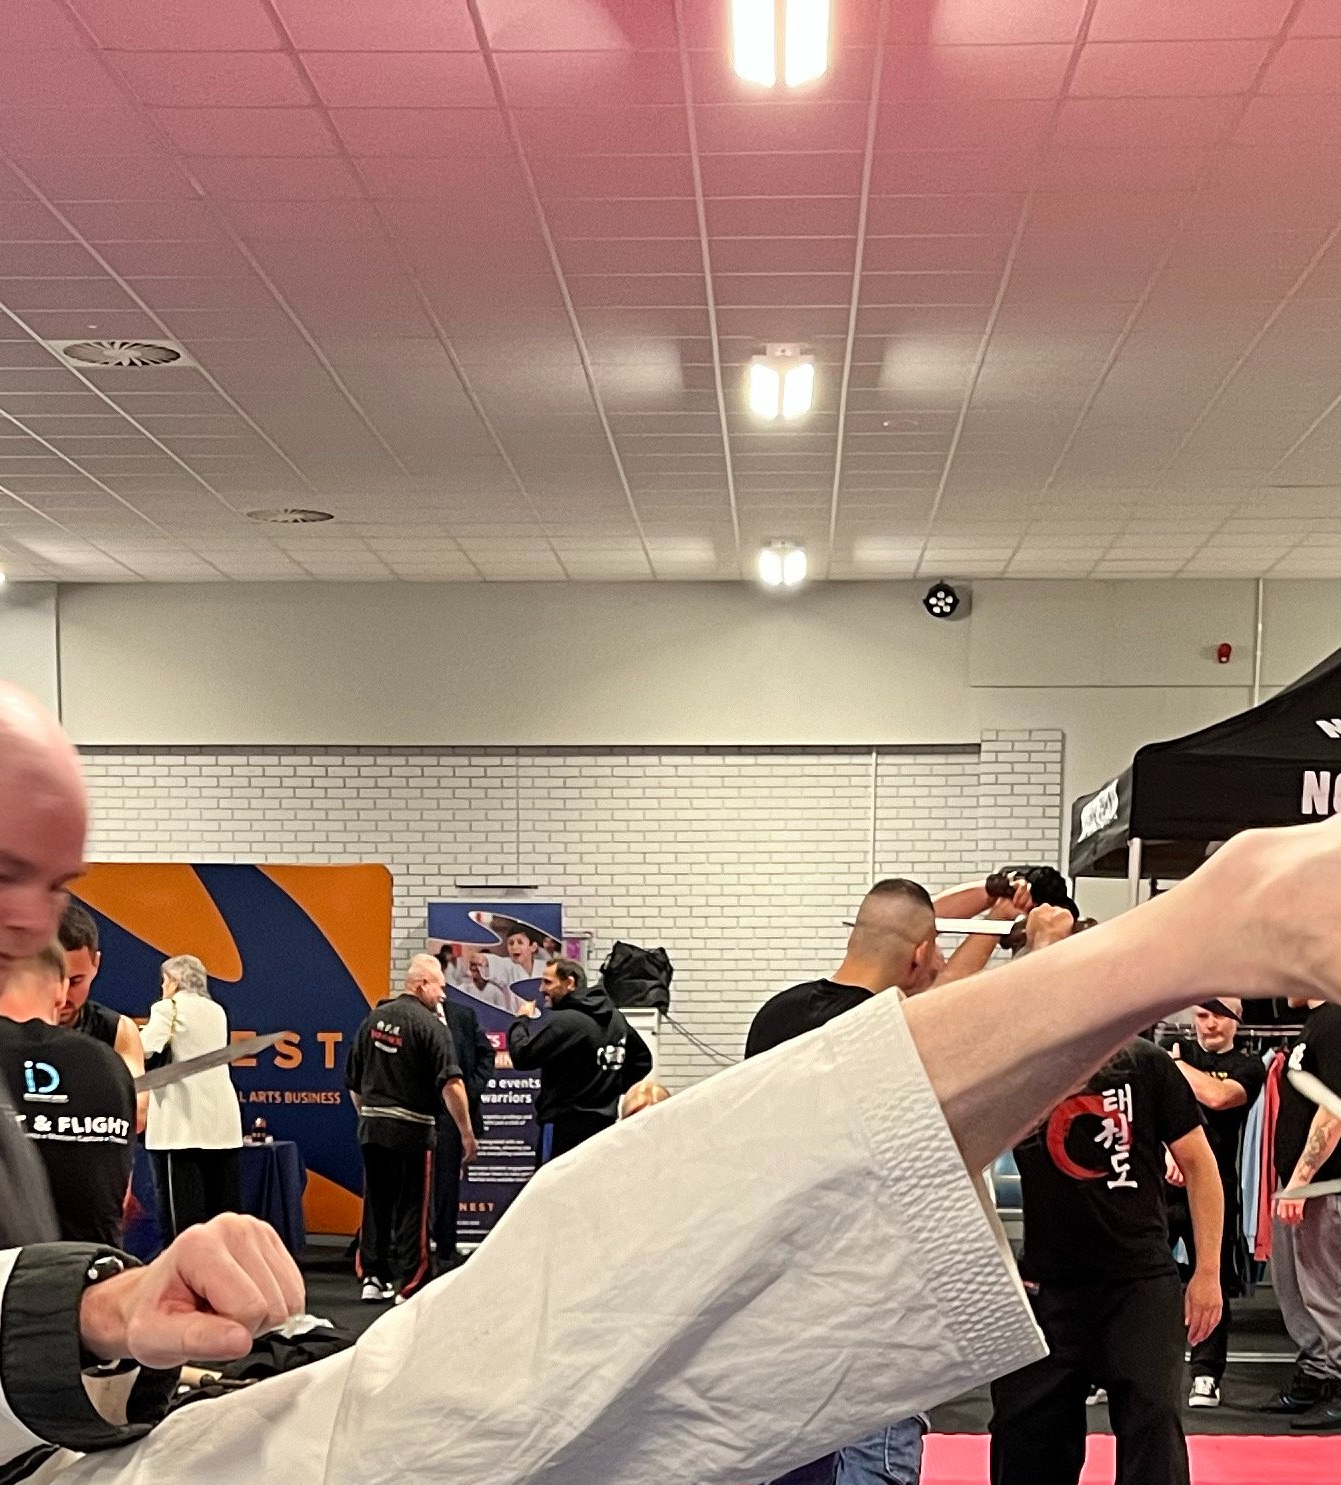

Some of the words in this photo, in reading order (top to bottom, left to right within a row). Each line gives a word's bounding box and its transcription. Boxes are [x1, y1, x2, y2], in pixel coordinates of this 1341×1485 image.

[230, 1031, 343, 1069] EST
[499, 1077, 541, 1089] events
[249, 1091, 282, 1104] ARTS
[284, 1091, 341, 1105] BUSINESS
[480, 1091, 532, 1104] warriors
[33, 1115, 52, 1132] &
[58, 1116, 130, 1137] FLIGHT
[459, 1202, 494, 1212] NEST
